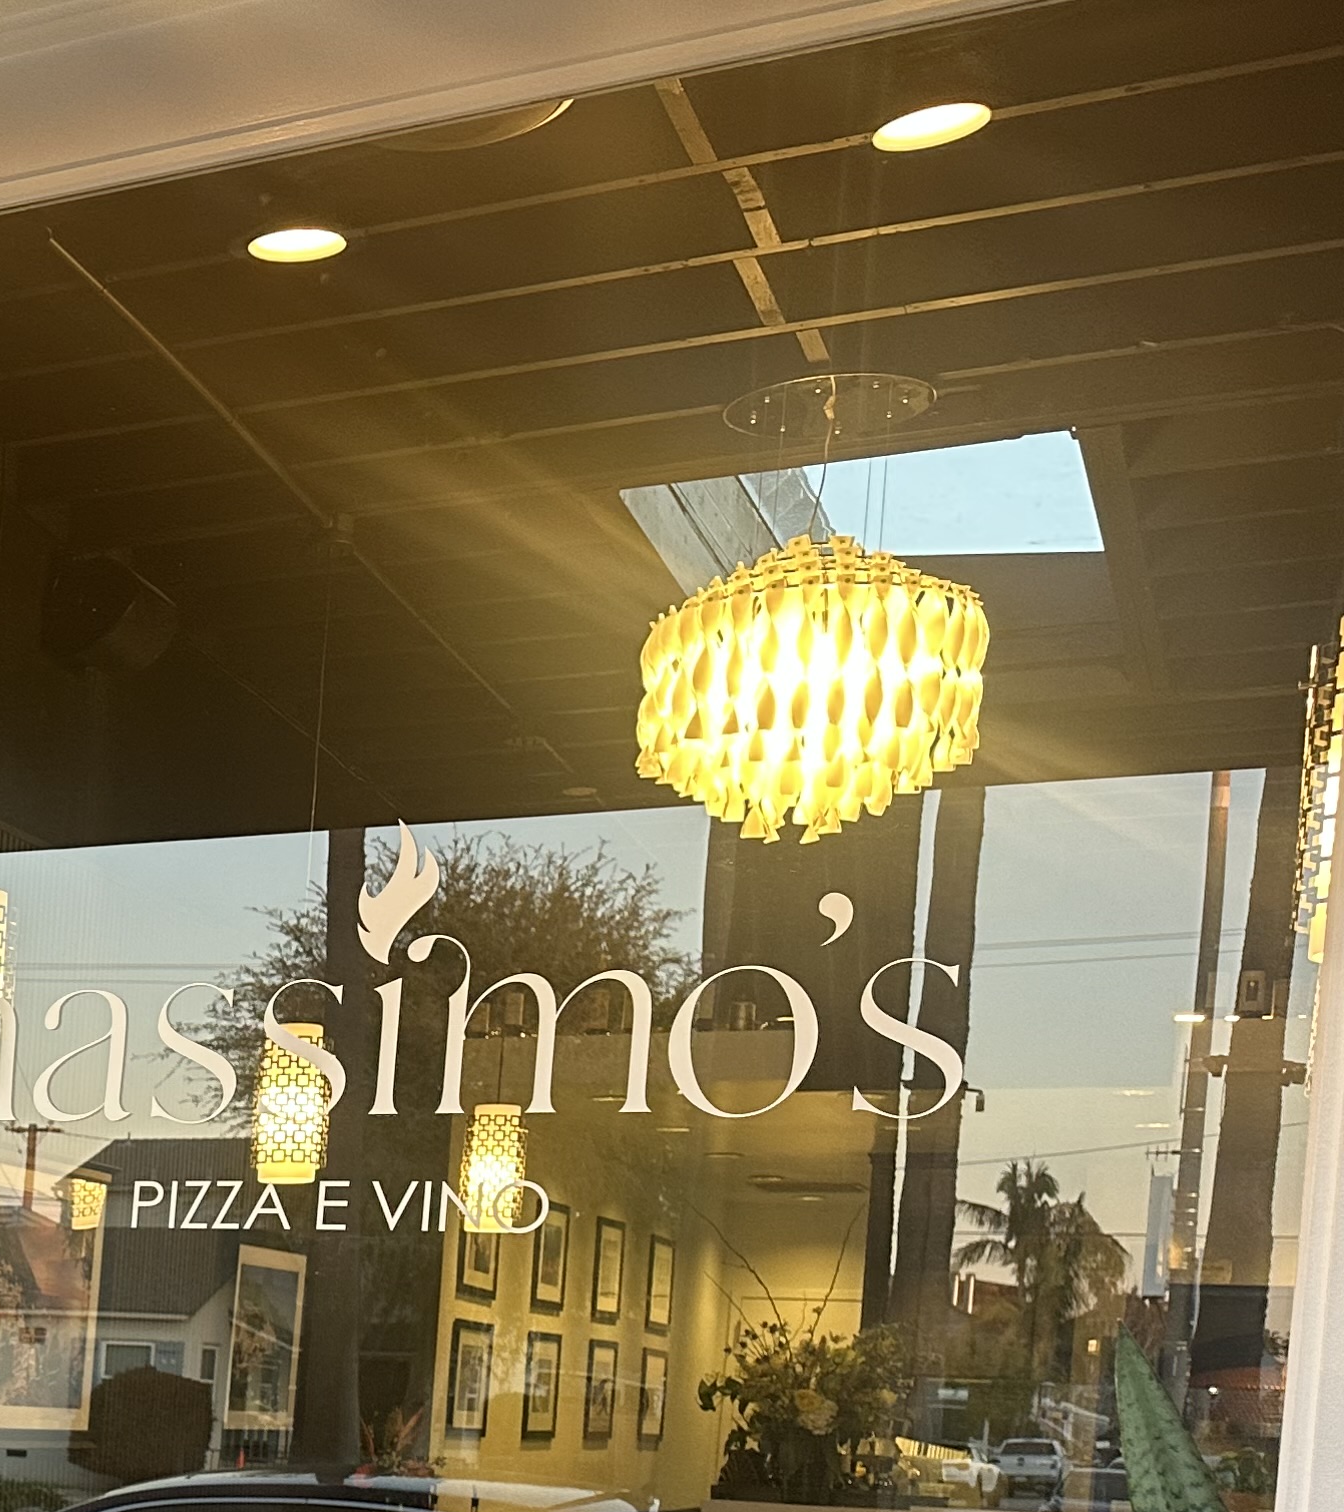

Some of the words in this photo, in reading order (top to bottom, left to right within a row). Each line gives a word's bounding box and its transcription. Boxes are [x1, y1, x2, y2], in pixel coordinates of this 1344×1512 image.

[130, 1180, 291, 1231] PIZZA
[315, 1180, 351, 1231] E
[372, 1179, 550, 1234] VINO
